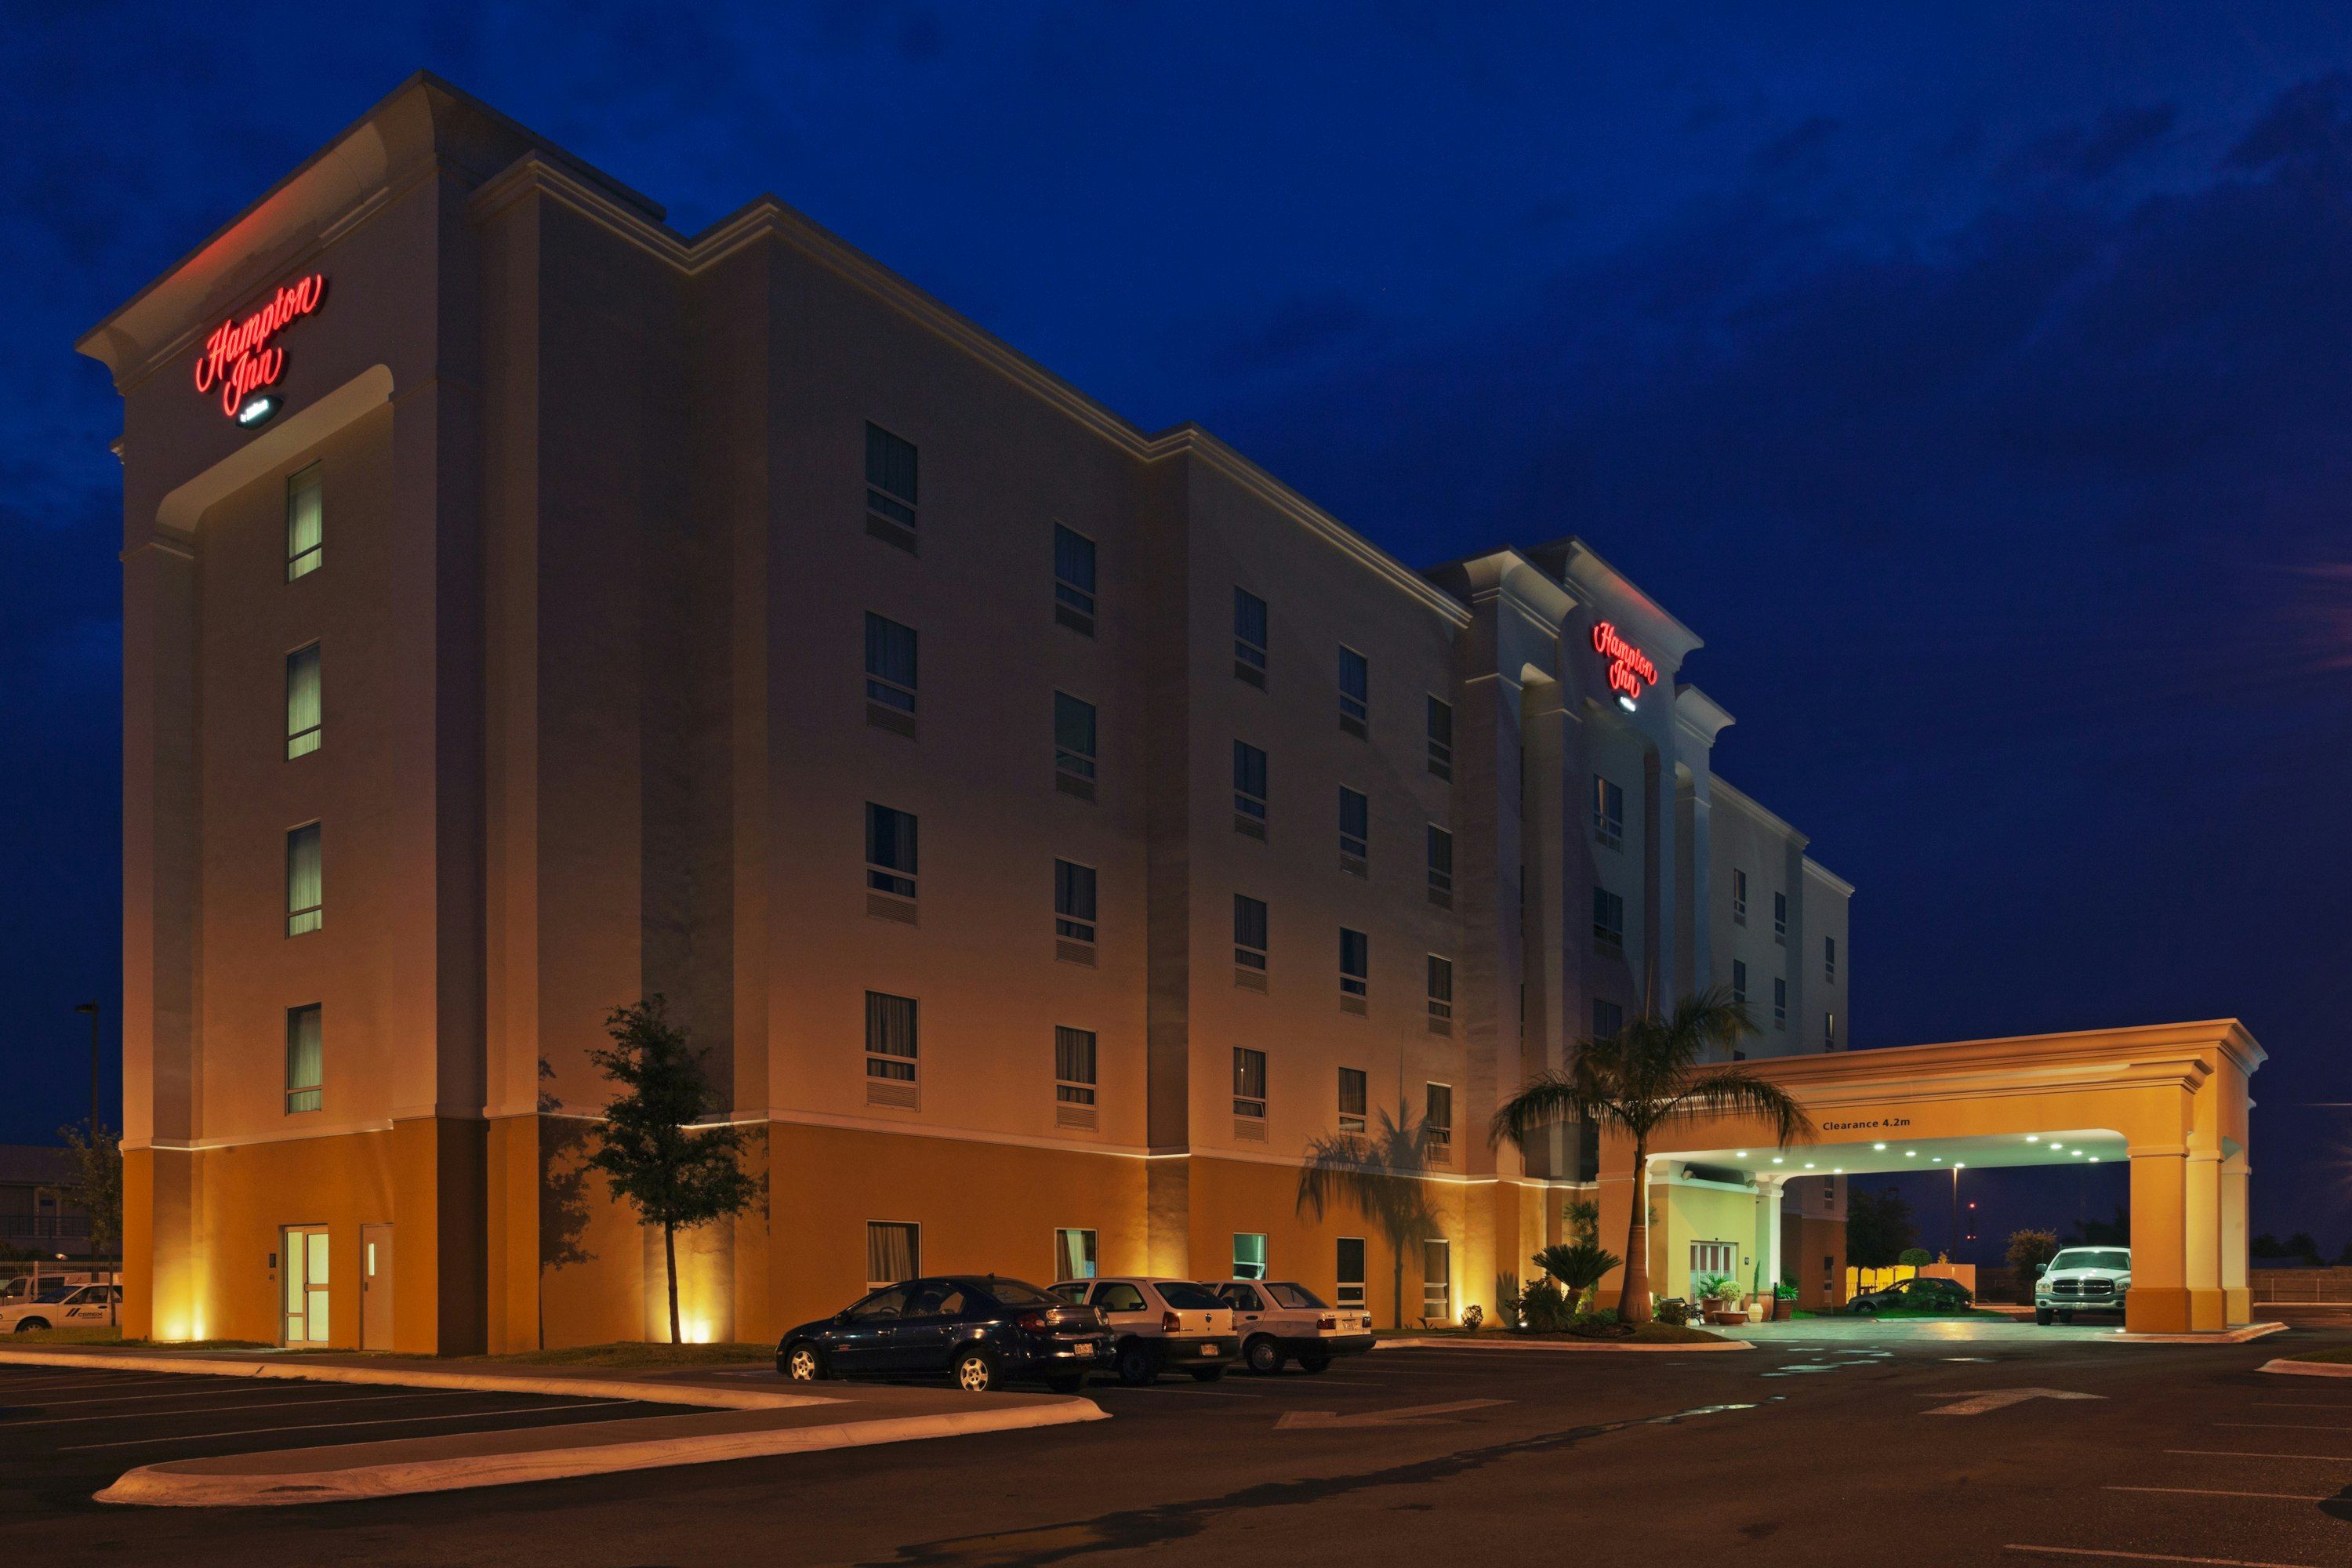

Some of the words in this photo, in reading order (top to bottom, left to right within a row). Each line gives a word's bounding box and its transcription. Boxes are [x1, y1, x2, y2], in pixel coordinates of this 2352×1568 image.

[195, 274, 322, 392] Hampton
[223, 347, 283, 417] Inn
[1593, 622, 1658, 685] Hampton
[1610, 659, 1640, 699] Inn
[1823, 1121, 1878, 1131] Clearance
[1882, 1118, 1911, 1127] 4.2m
